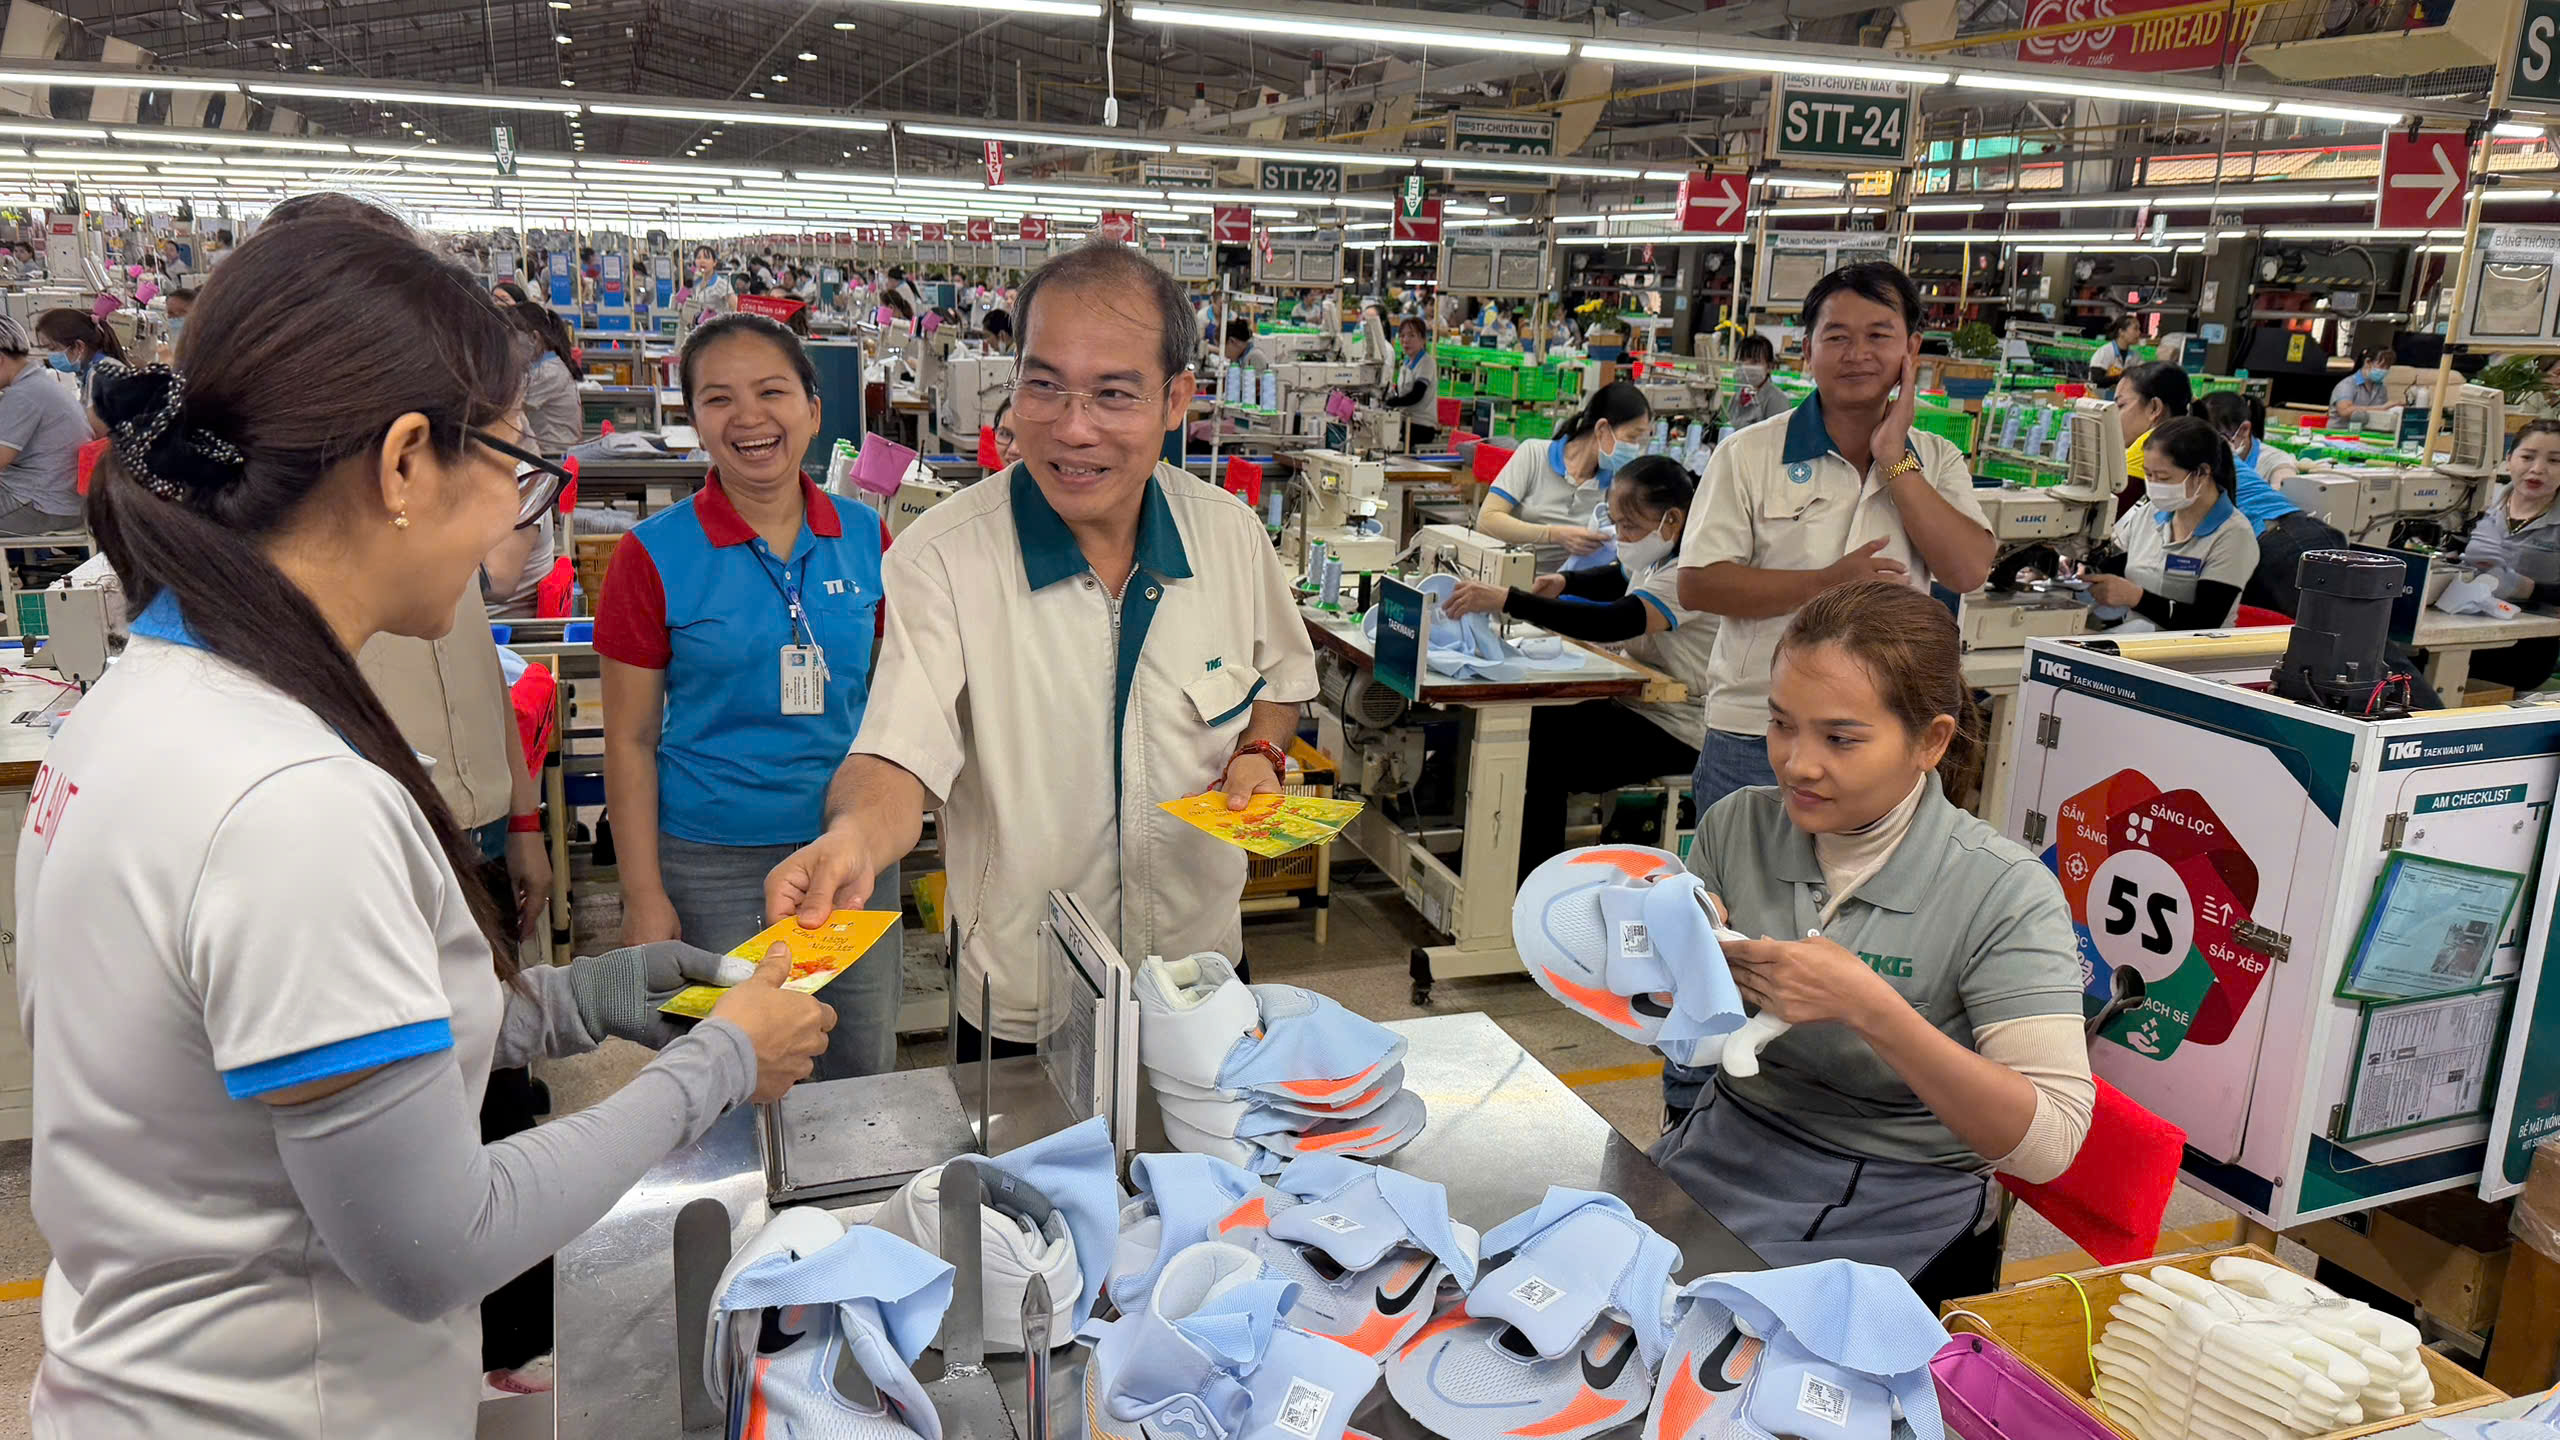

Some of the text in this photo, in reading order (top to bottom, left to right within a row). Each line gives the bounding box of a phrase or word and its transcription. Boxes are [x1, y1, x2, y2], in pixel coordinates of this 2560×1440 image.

[2130, 10, 2223, 54] THREAD
[1870, 79, 1892, 93] MAY
[1785, 100, 1901, 148] STT-24
[991, 152, 998, 172] PM
[1264, 166, 1338, 192] STT-22
[2015, 515, 2047, 523] JUKI
[1205, 656, 1222, 672] TKG
[2038, 658, 2136, 700] TKG TAEKWANG VINA
[2387, 740, 2484, 761] TKG TAEKWANG VINA
[23, 765, 79, 856] PLANT
[2431, 788, 2512, 809] AM CHECKLIST
[2150, 803, 2215, 836] SÀNG LỌC
[2077, 824, 2108, 846] SÀNG
[2105, 874, 2178, 955] 5S
[1068, 926, 1083, 956] PFC
[1858, 951, 1912, 977] TKG
[2208, 941, 2265, 976] SẮP XẾP
